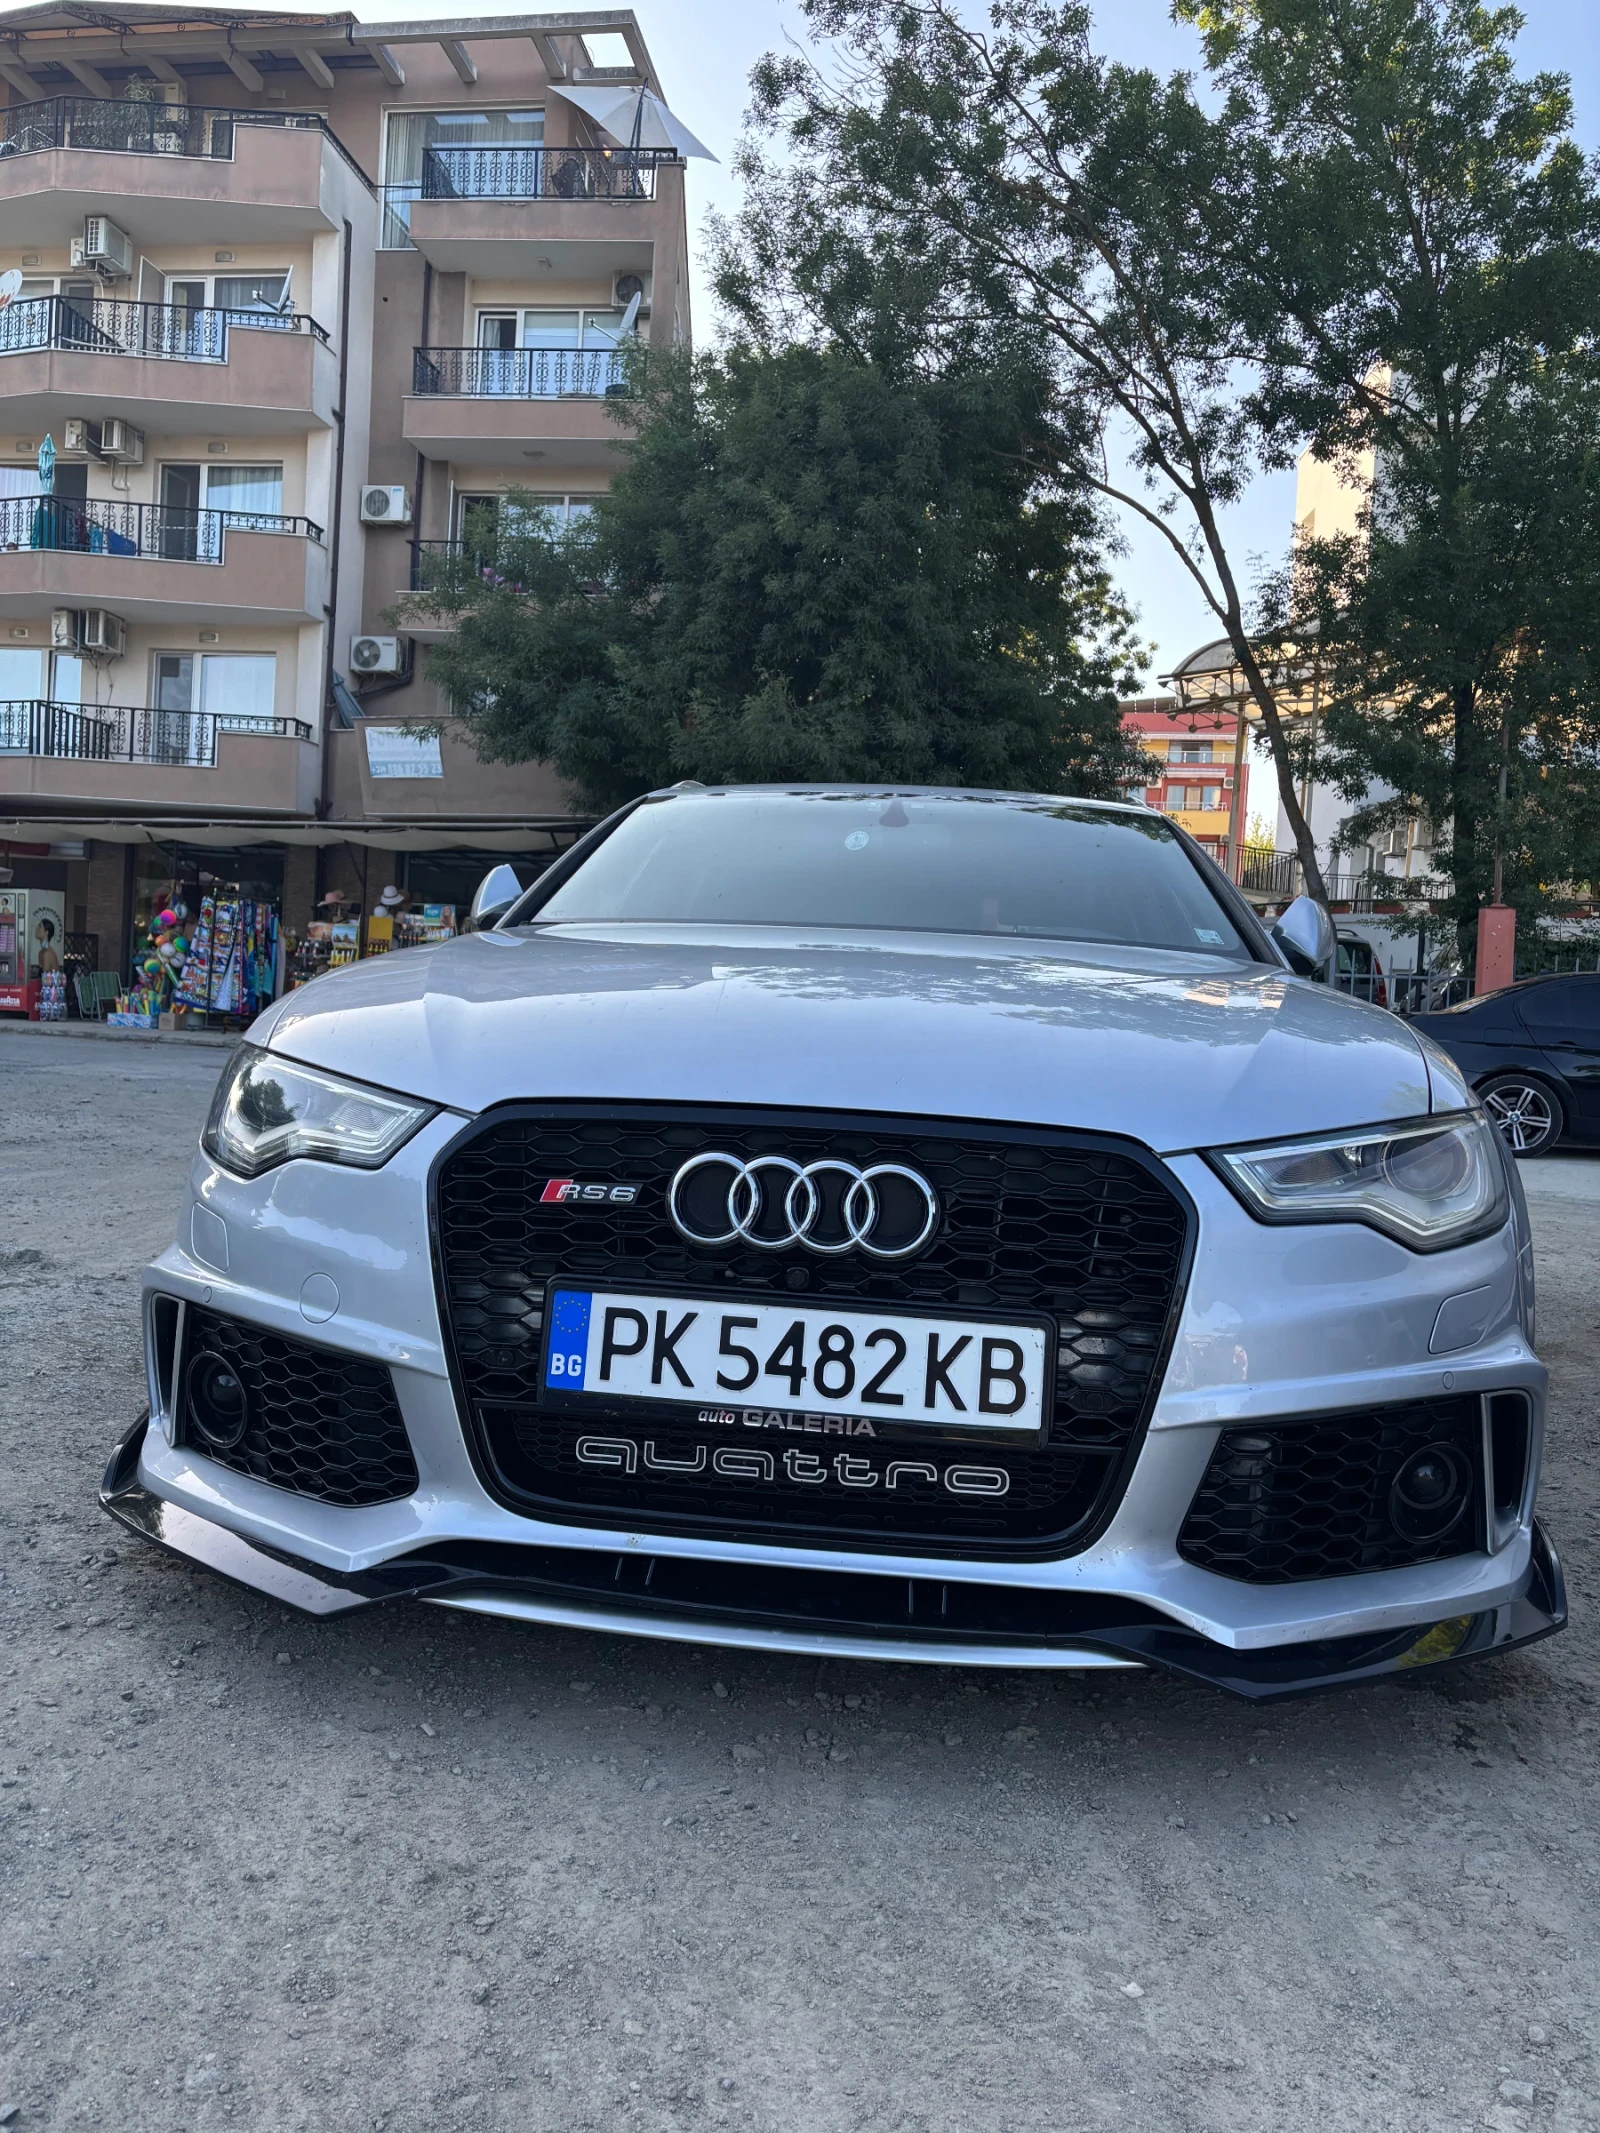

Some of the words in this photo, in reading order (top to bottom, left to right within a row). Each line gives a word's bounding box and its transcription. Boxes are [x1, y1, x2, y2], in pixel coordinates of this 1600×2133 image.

[556, 1184, 636, 1202] RS6
[550, 1353, 582, 1377] BG
[599, 1306, 699, 1388] PK
[716, 1315, 907, 1406] 5482
[924, 1332, 1027, 1415] KB
[698, 1408, 736, 1425] auto
[742, 1408, 876, 1437] GALERIA
[575, 1435, 1011, 1496] quattro
